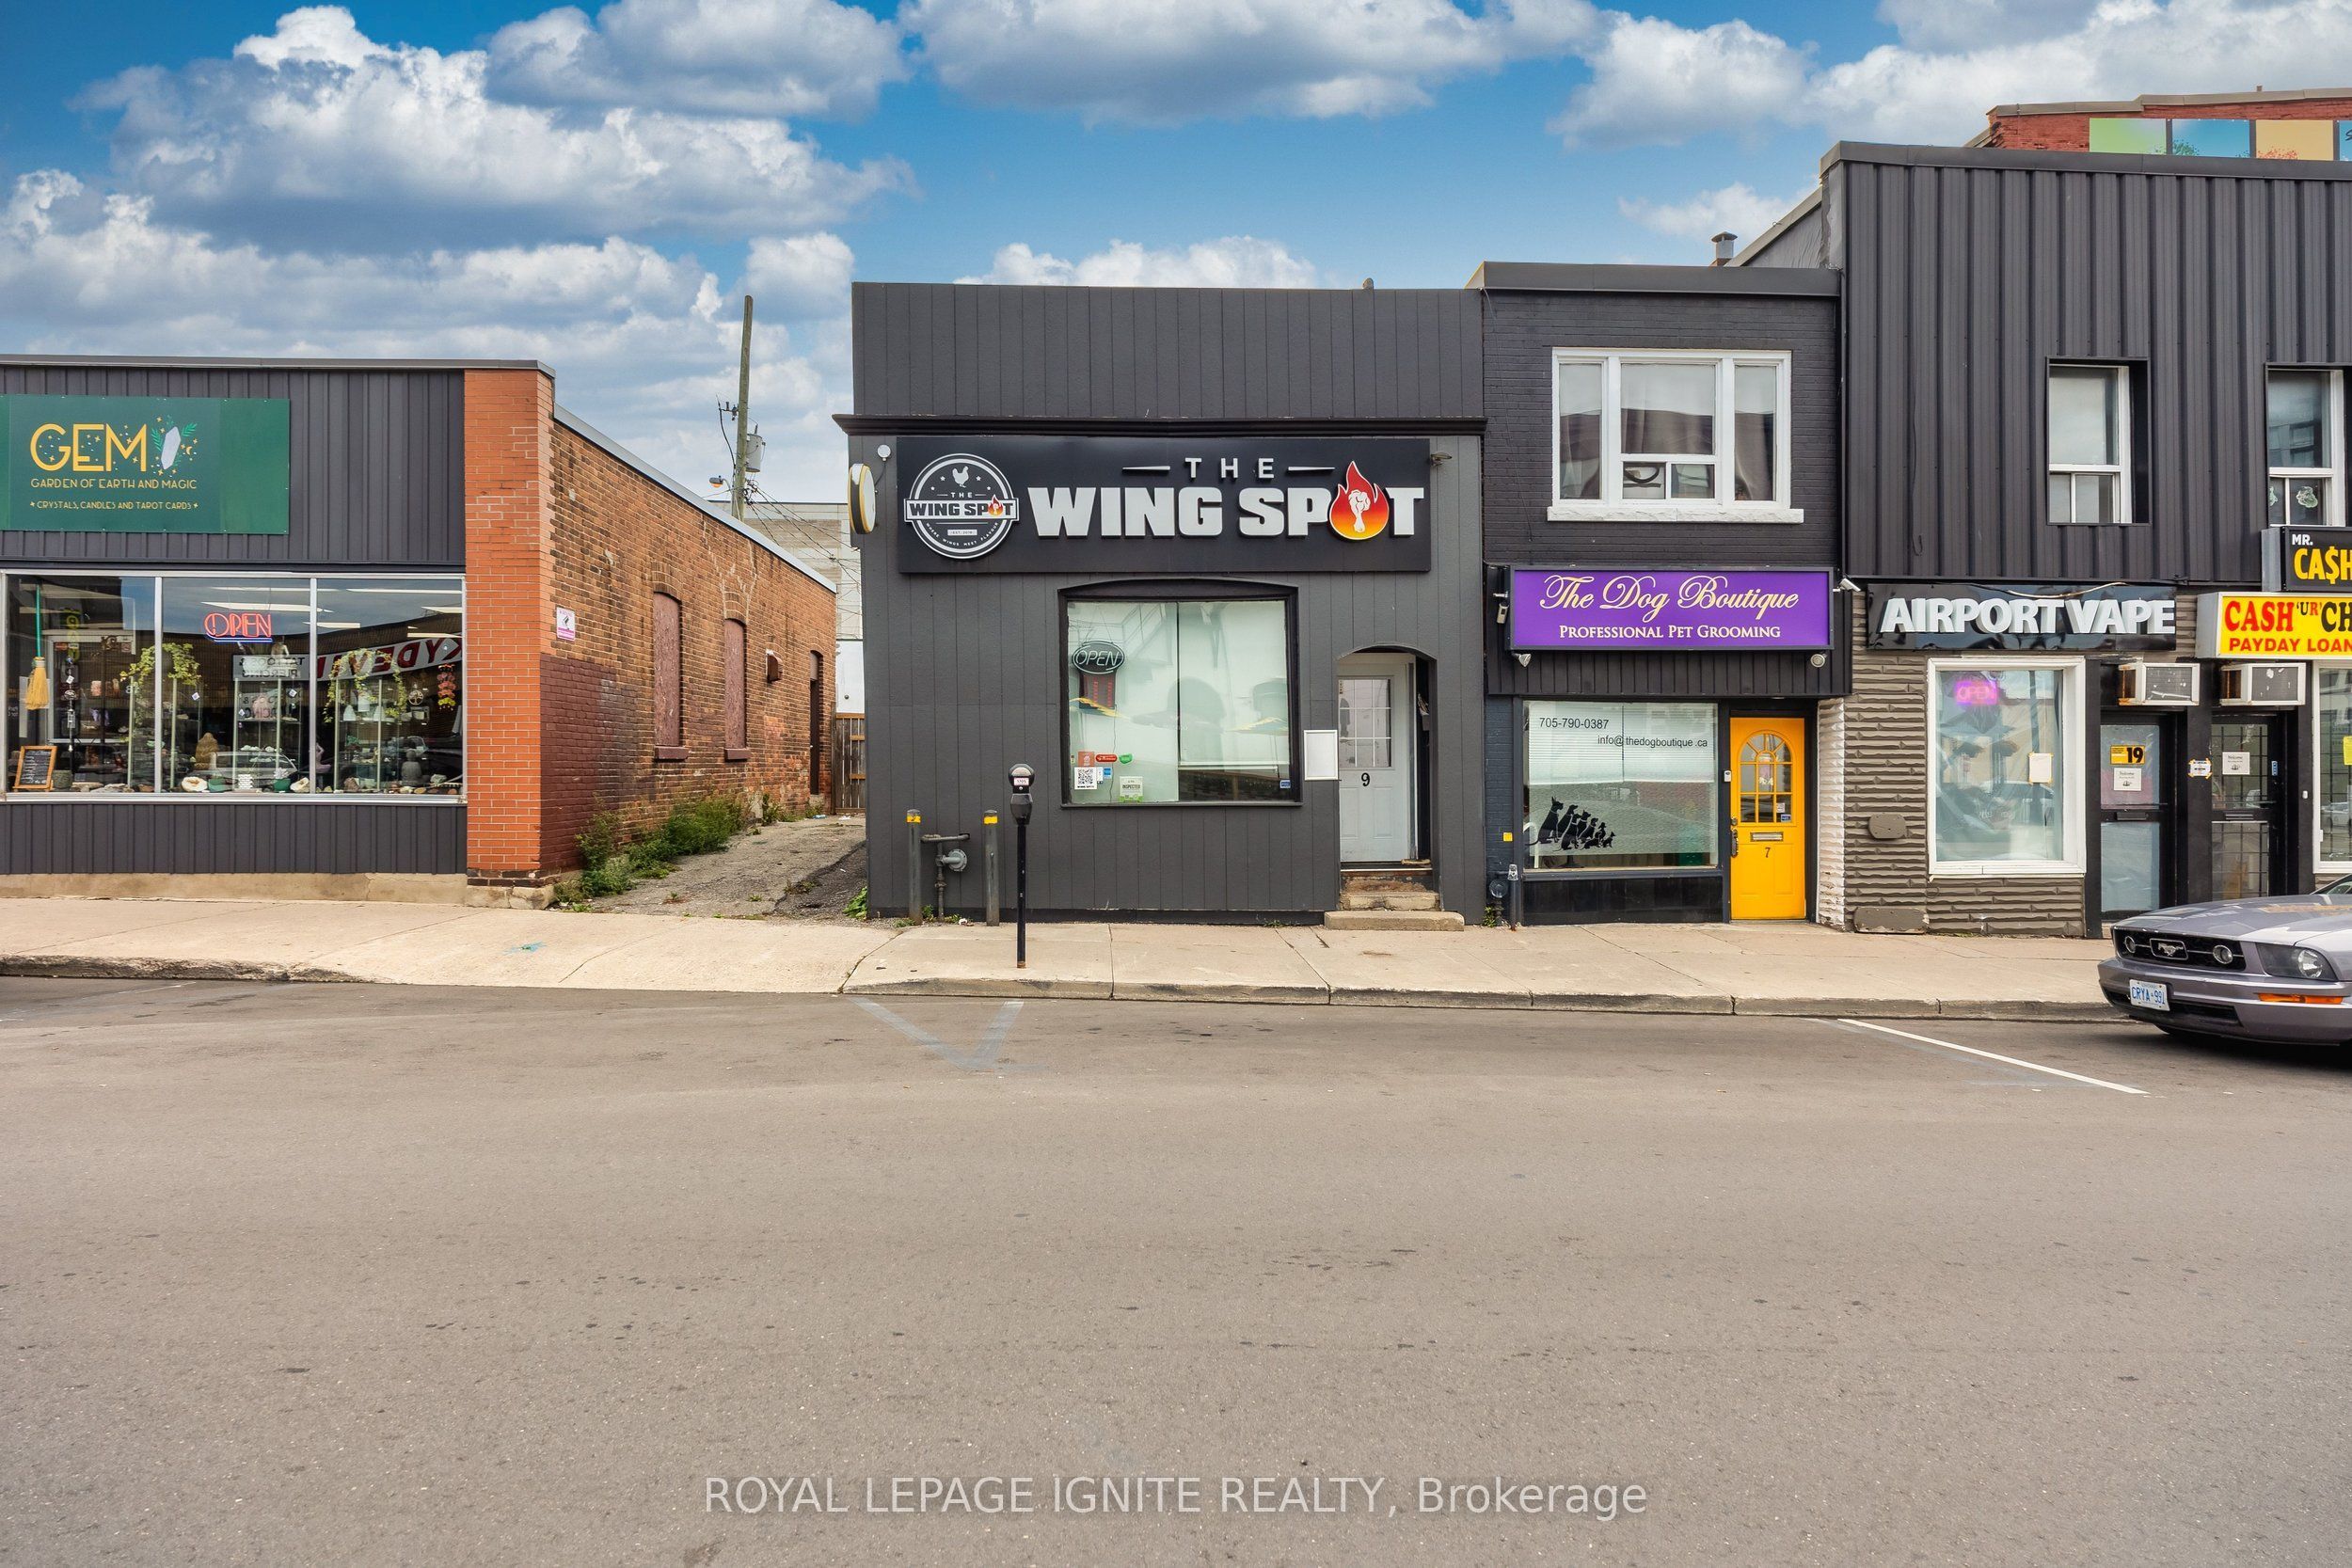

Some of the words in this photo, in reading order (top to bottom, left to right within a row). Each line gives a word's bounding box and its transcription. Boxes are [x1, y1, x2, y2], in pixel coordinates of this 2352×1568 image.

[30, 423, 148, 471] GEM
[1184, 457, 1275, 479] THE
[30, 478, 79, 489] GARDEN
[80, 478, 96, 489] OF
[98, 479, 135, 489] EARTH
[137, 479, 159, 489] AND
[162, 479, 198, 490] MAGIC
[80, 501, 116, 510] CANDLES
[118, 501, 134, 510] AND
[136, 501, 164, 510] TAROT
[166, 501, 192, 510] CARDS
[909, 502, 961, 516] WING
[1027, 486, 1223, 537] WING
[2291, 533, 2313, 546] MR.
[1539, 575, 1596, 610] The
[1598, 575, 1671, 623] Dog
[1677, 575, 1800, 620] Boutique
[1880, 597, 2065, 635] AIRPORT
[2065, 598, 2176, 635] VAPE
[2224, 600, 2295, 632] CASH
[203, 612, 272, 638] OPEN
[1559, 625, 1664, 639] PROFESSIONAL
[1668, 625, 1693, 639] PET
[1696, 625, 1781, 639] GROOMING
[2229, 637, 2301, 652] PAYDAY
[1075, 649, 1120, 666] OPEN
[1539, 718, 1609, 730] 705-790-0387
[2126, 746, 2144, 763] 19
[1360, 772, 1371, 787] 9
[1765, 847, 1772, 858] 7
